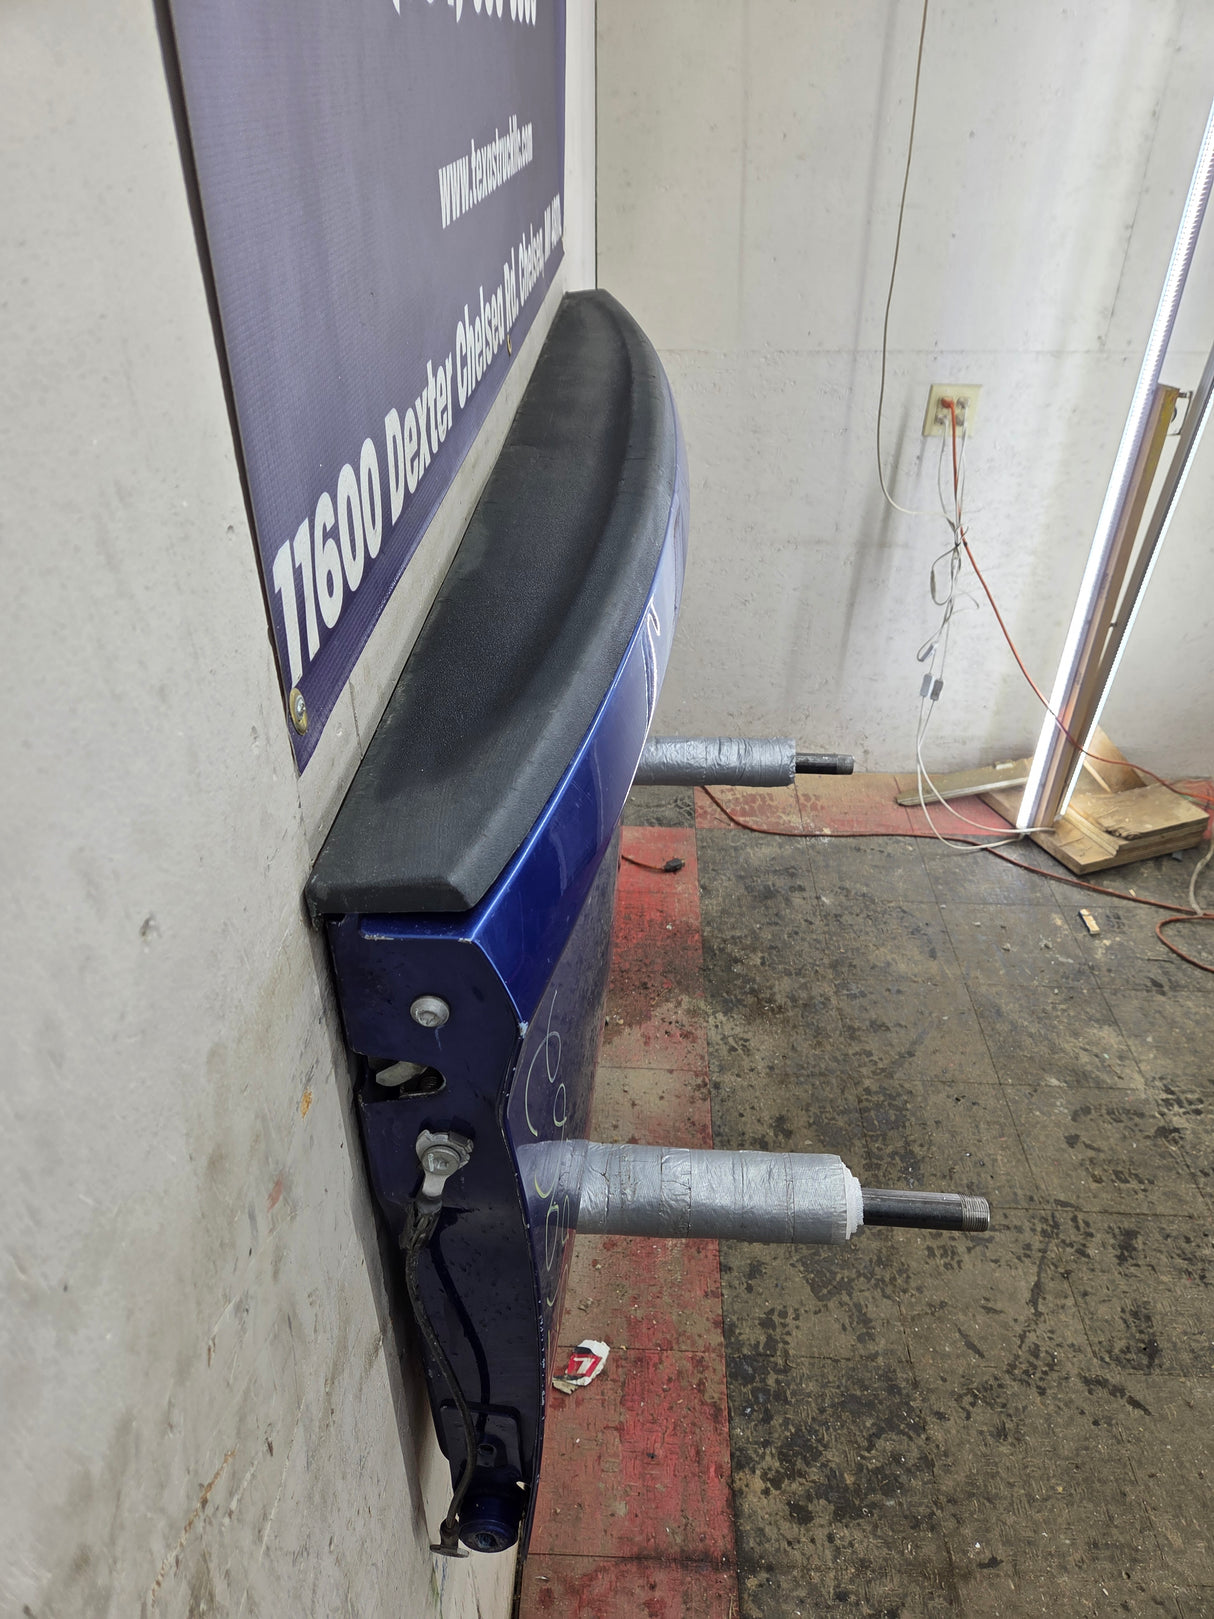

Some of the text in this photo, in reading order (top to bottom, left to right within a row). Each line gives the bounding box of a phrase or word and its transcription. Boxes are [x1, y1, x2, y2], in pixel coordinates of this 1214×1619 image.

[272, 437, 383, 688] 11600
[385, 352, 453, 525] Dexter
[456, 285, 505, 409] Chelsea
[504, 247, 519, 333] Rd.
